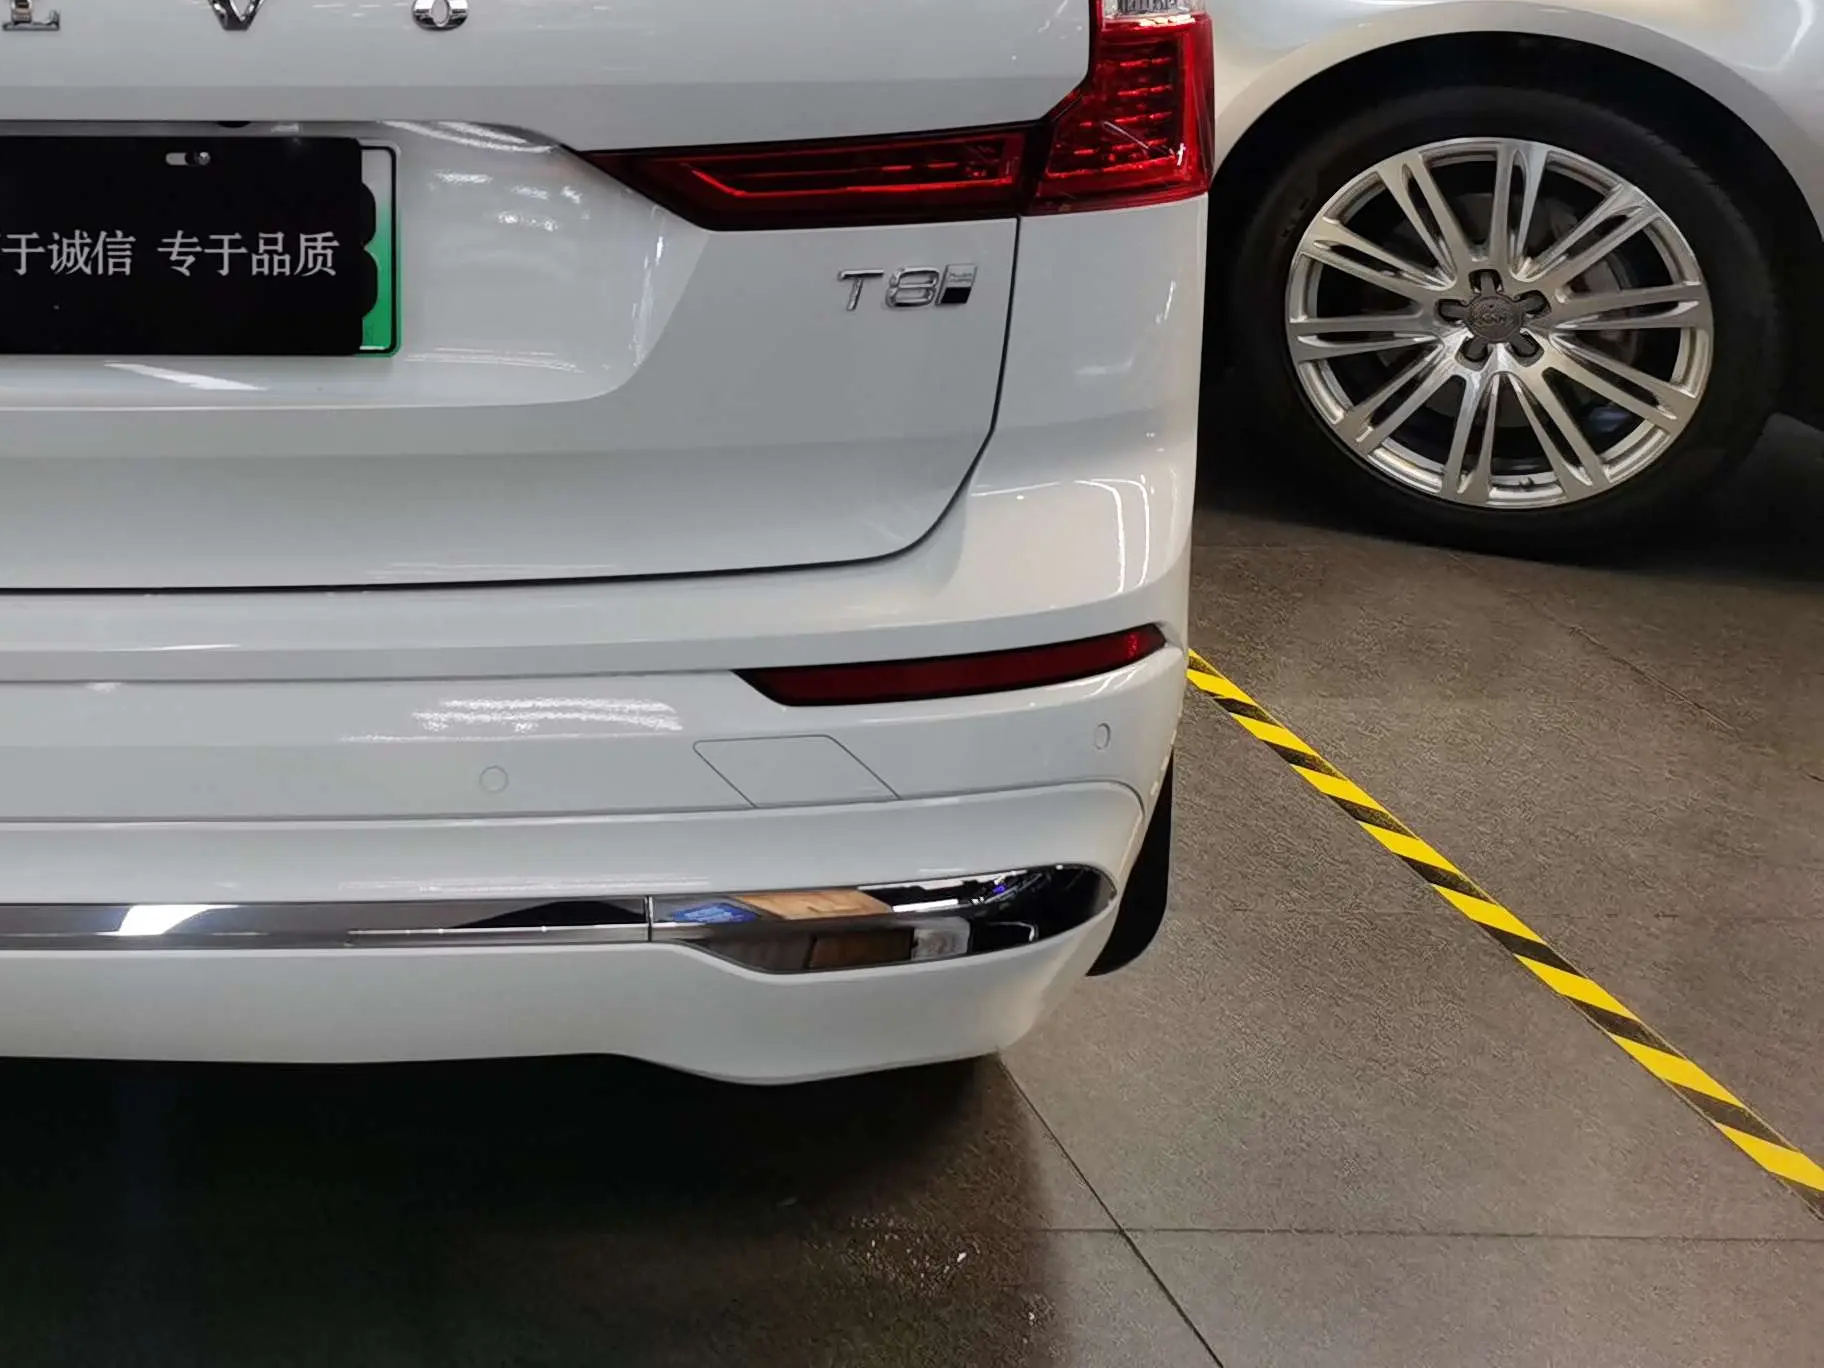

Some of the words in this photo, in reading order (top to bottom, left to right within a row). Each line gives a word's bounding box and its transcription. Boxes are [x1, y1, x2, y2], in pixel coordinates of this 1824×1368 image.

[157, 229, 340, 277] 专于品质
[837, 266, 940, 312] T8
